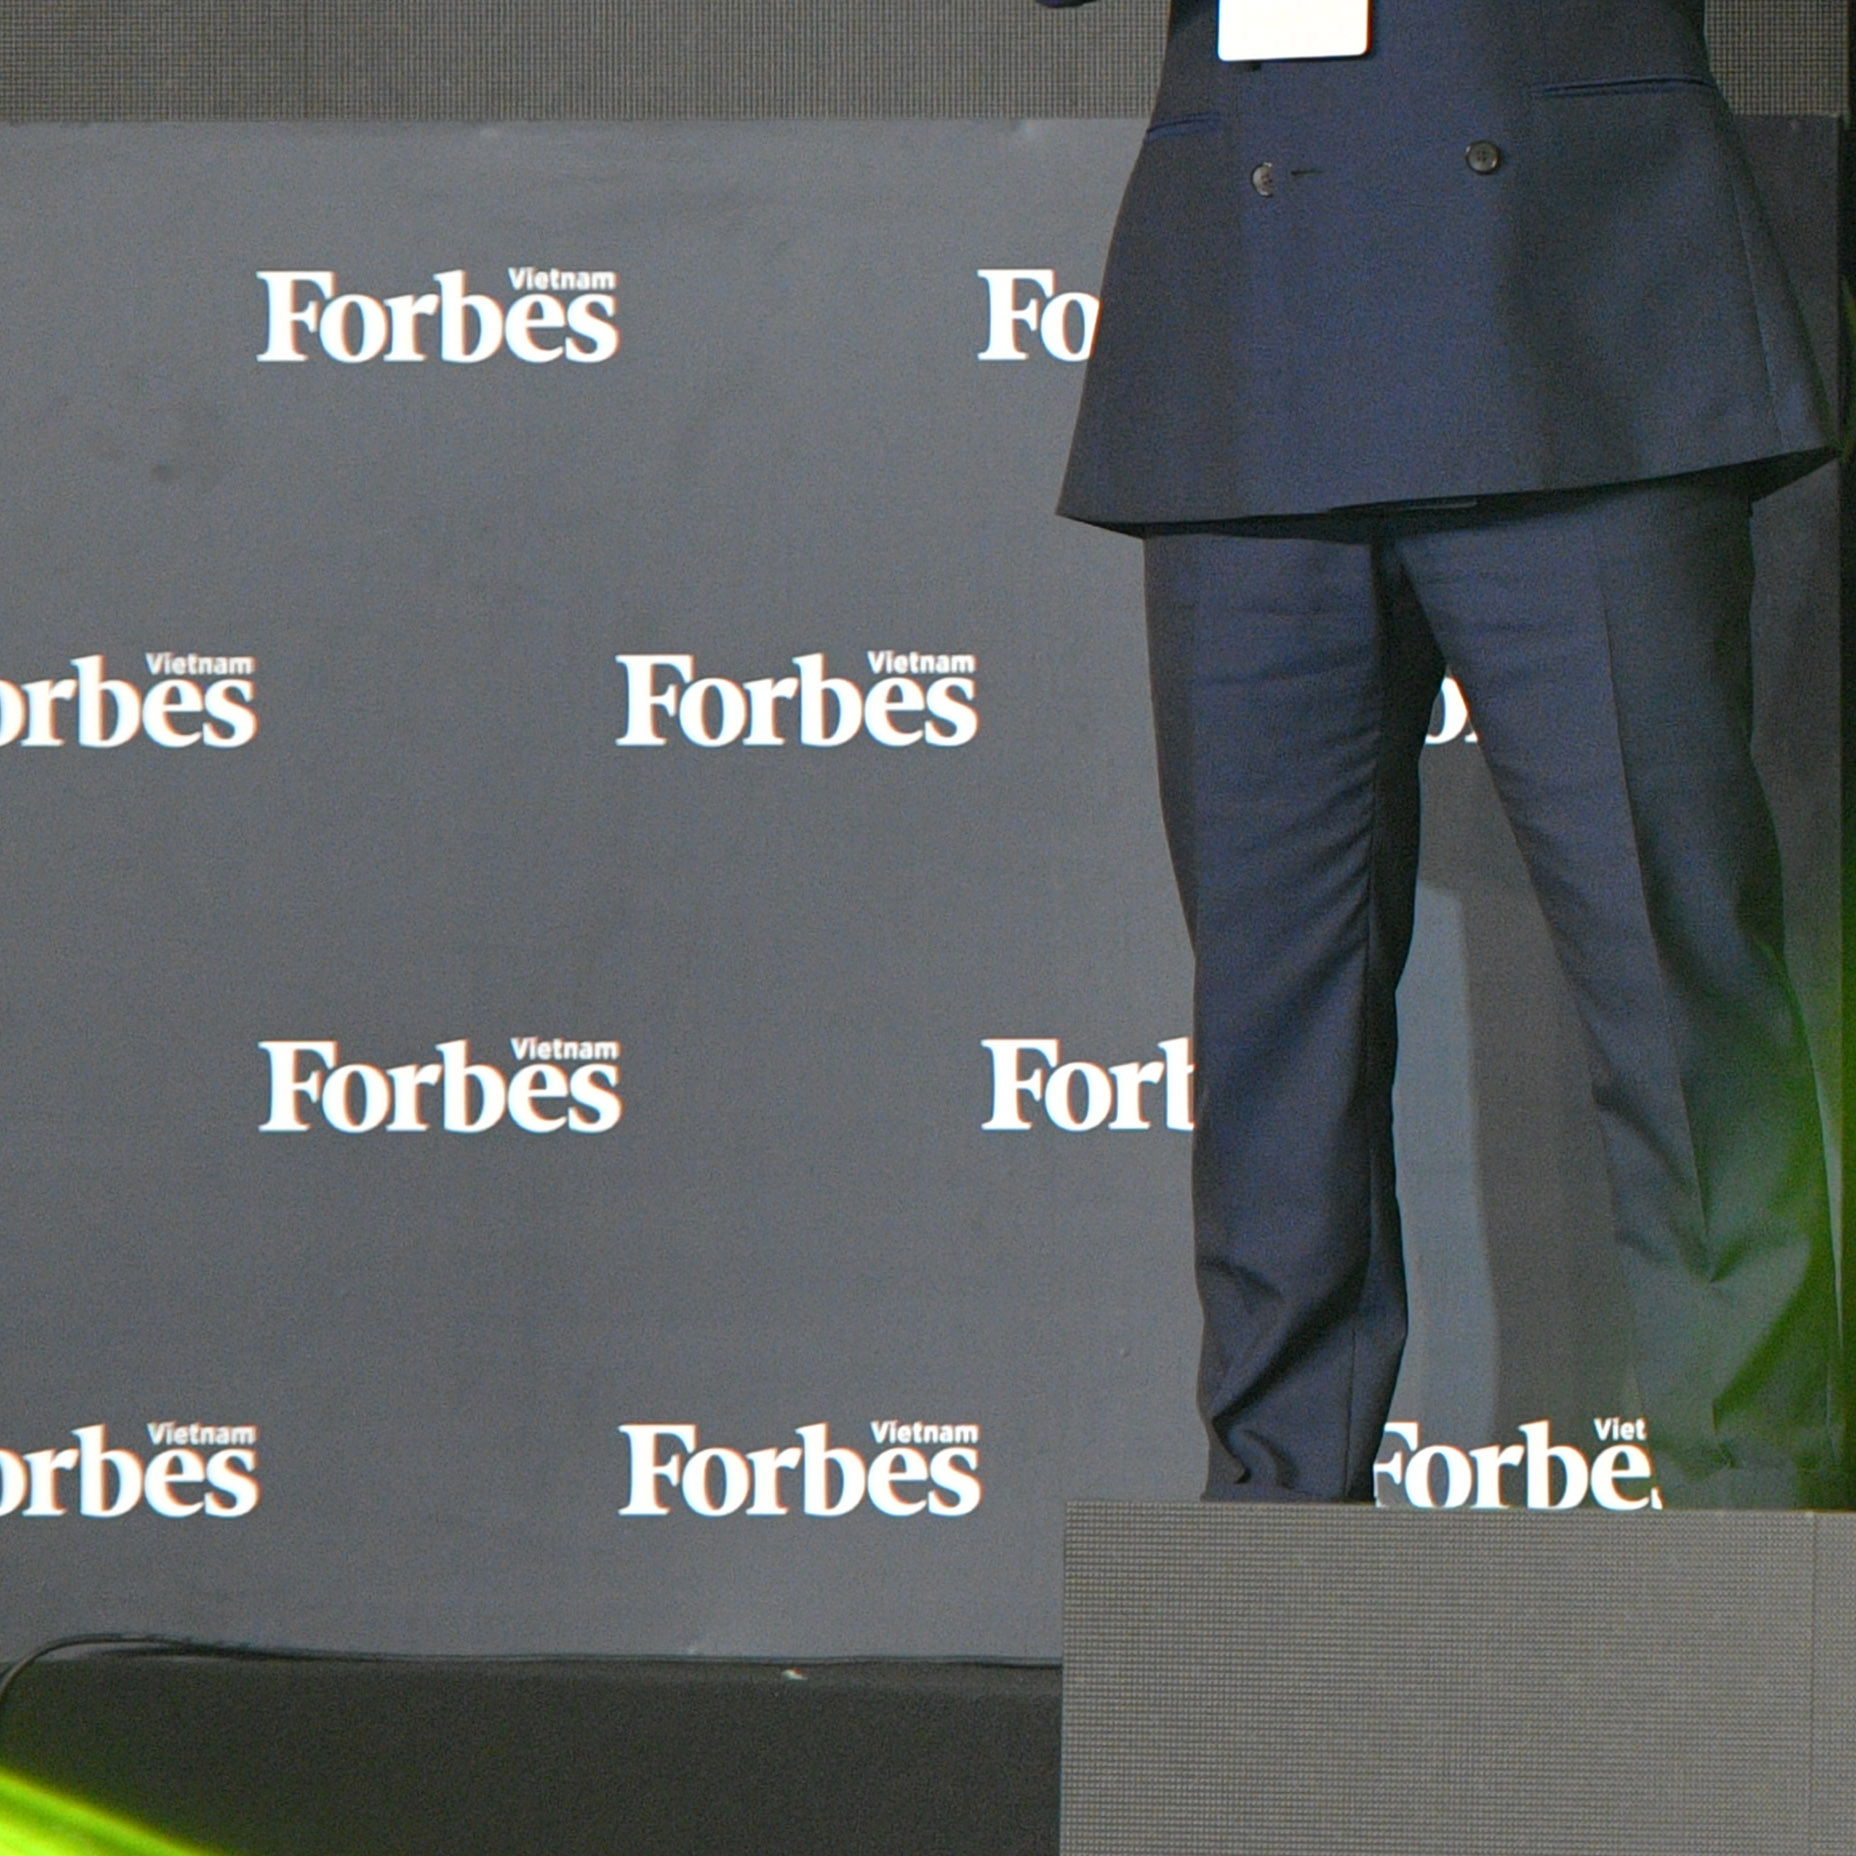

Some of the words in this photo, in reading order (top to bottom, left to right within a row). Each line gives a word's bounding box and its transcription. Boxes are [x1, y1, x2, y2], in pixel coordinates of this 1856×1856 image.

[508, 267, 617, 290] Vietnam
[257, 268, 619, 364] Forbes
[146, 652, 254, 676] Vietnam
[867, 650, 976, 674] Vietnam
[615, 652, 978, 747] Forbes
[510, 1036, 619, 1060] Vietnam
[258, 1039, 621, 1133] Forbes
[148, 1422, 256, 1446] Vietnam
[870, 1420, 979, 1444] Vietnam
[1594, 1417, 1647, 1441] Viet
[618, 1423, 981, 1517] Forbes
[1373, 1420, 1663, 1510] Forbe
